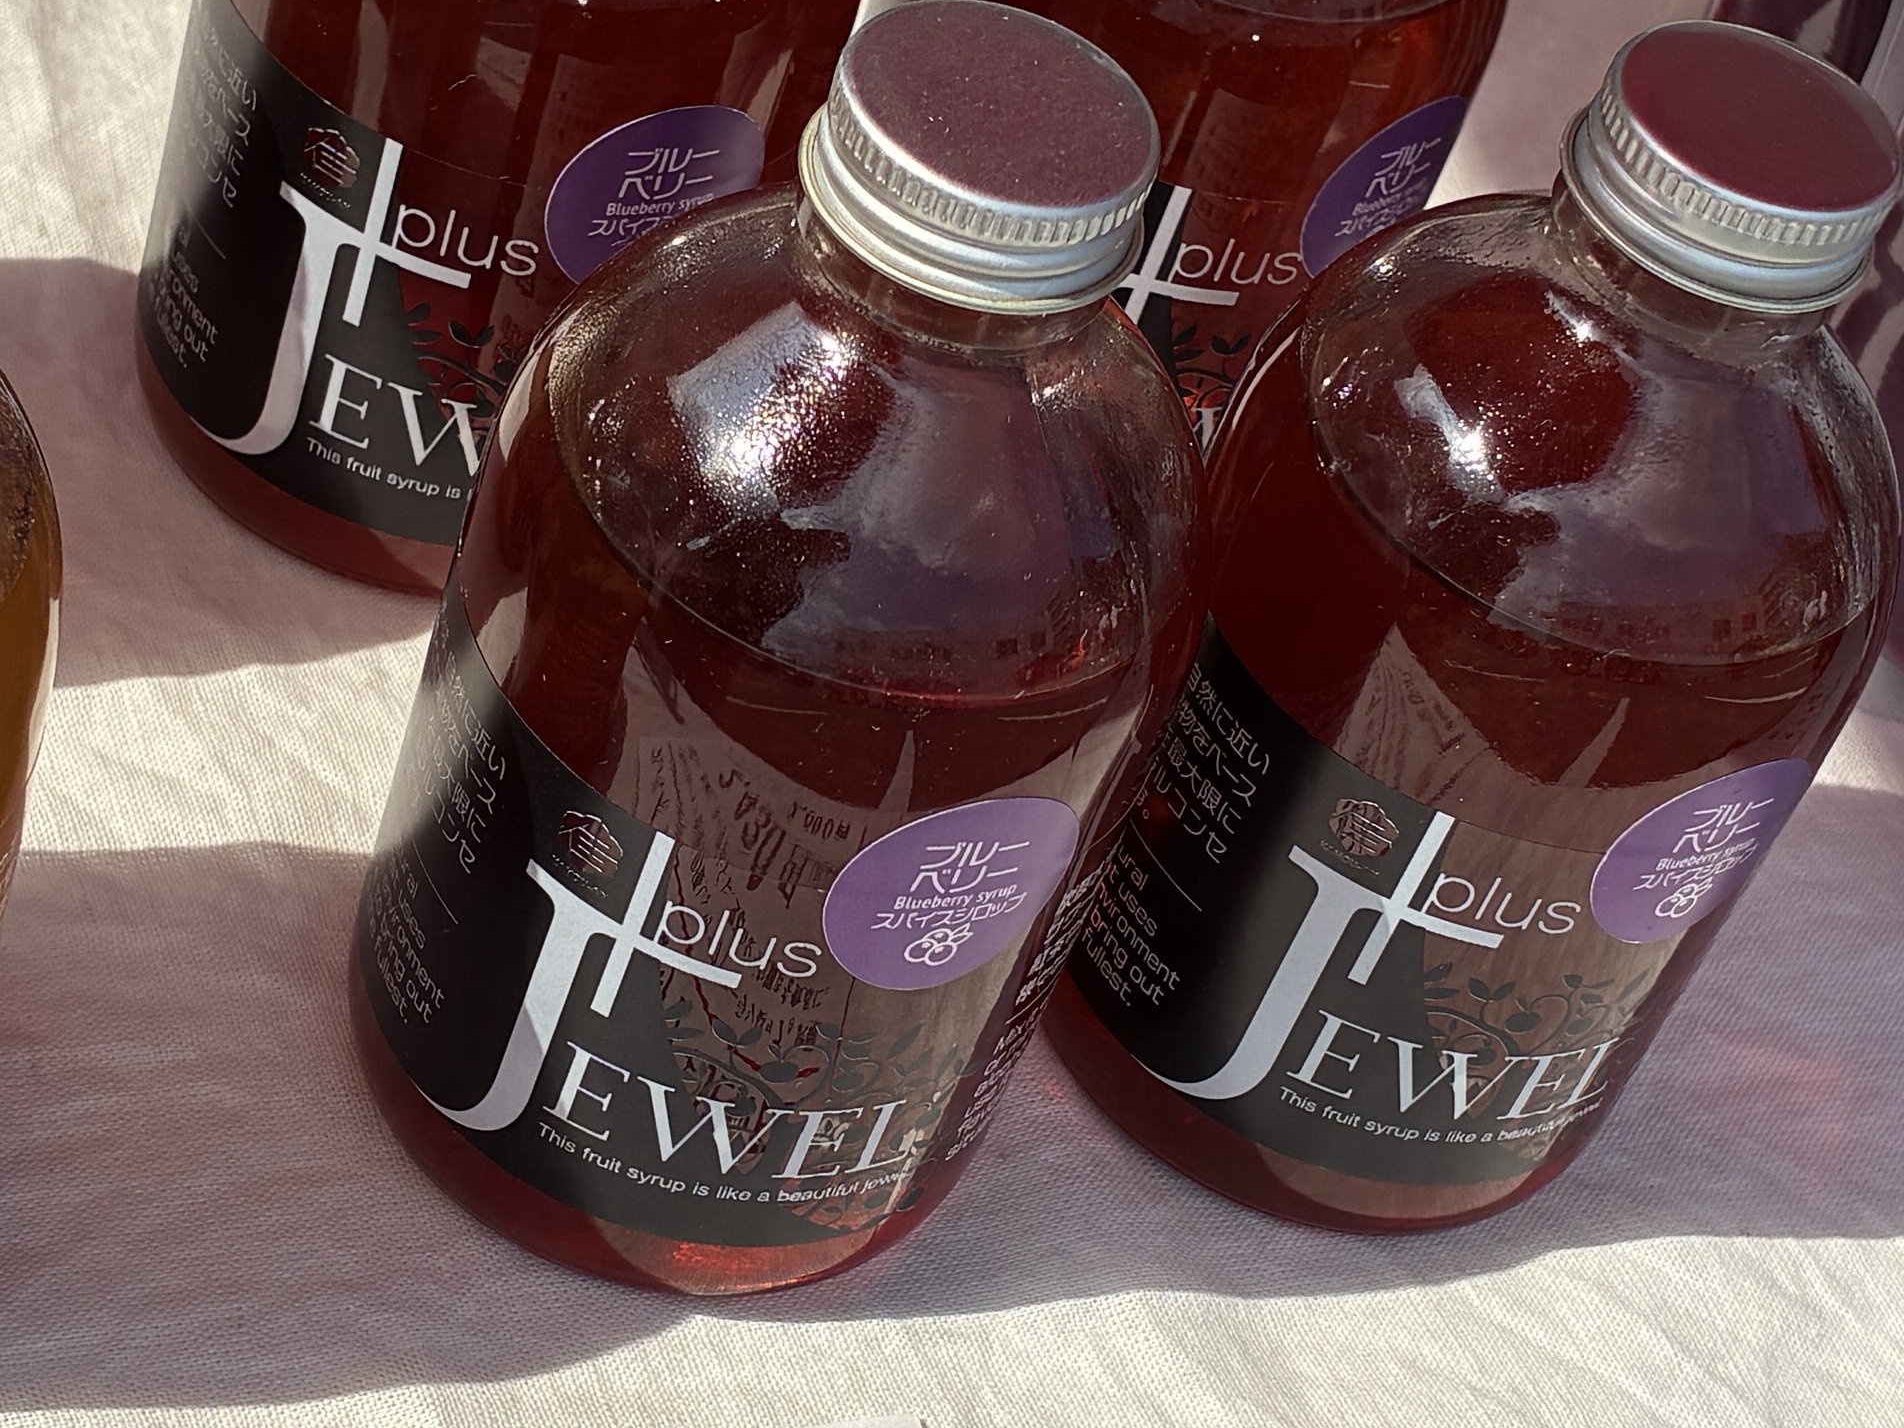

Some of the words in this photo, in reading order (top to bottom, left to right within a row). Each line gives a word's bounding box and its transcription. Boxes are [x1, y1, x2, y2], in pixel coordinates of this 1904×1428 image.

[624, 147, 720, 175] ブルー
[618, 172, 713, 200] ベリー
[606, 201, 675, 216] Blueberry
[395, 200, 540, 276] plus
[1175, 238, 1302, 287] plus
[307, 437, 341, 465] This
[346, 457, 382, 481] fruit
[387, 473, 440, 497] syrup
[446, 484, 461, 499] is
[1684, 797, 1775, 832] ブルー
[920, 841, 1031, 870] ブルー
[1672, 821, 1761, 854] ベリー
[909, 865, 1019, 894] ベリー
[1655, 851, 1721, 871] Blueberry
[870, 892, 1028, 930] スパイスシロップ
[893, 892, 974, 911] Blueberry
[976, 883, 1018, 904] syrup
[1117, 888, 1158, 938] uses
[1431, 869, 1582, 936] plus
[655, 888, 824, 979] plus
[405, 975, 434, 1024] out
[1129, 964, 1164, 1006] out
[1280, 1086, 1316, 1114] This
[1322, 1105, 1361, 1128] fruit
[1364, 1119, 1420, 1142] syrup
[1424, 1128, 1440, 1143] is
[1445, 1130, 1476, 1144] like
[1480, 1132, 1492, 1143] a
[537, 1121, 576, 1155] This
[582, 1145, 622, 1174] fruit
[626, 1165, 687, 1195] syrup
[692, 1180, 710, 1198] is
[716, 1183, 752, 1202] like
[757, 1189, 771, 1203] a
[777, 1182, 859, 1203] beautiful
